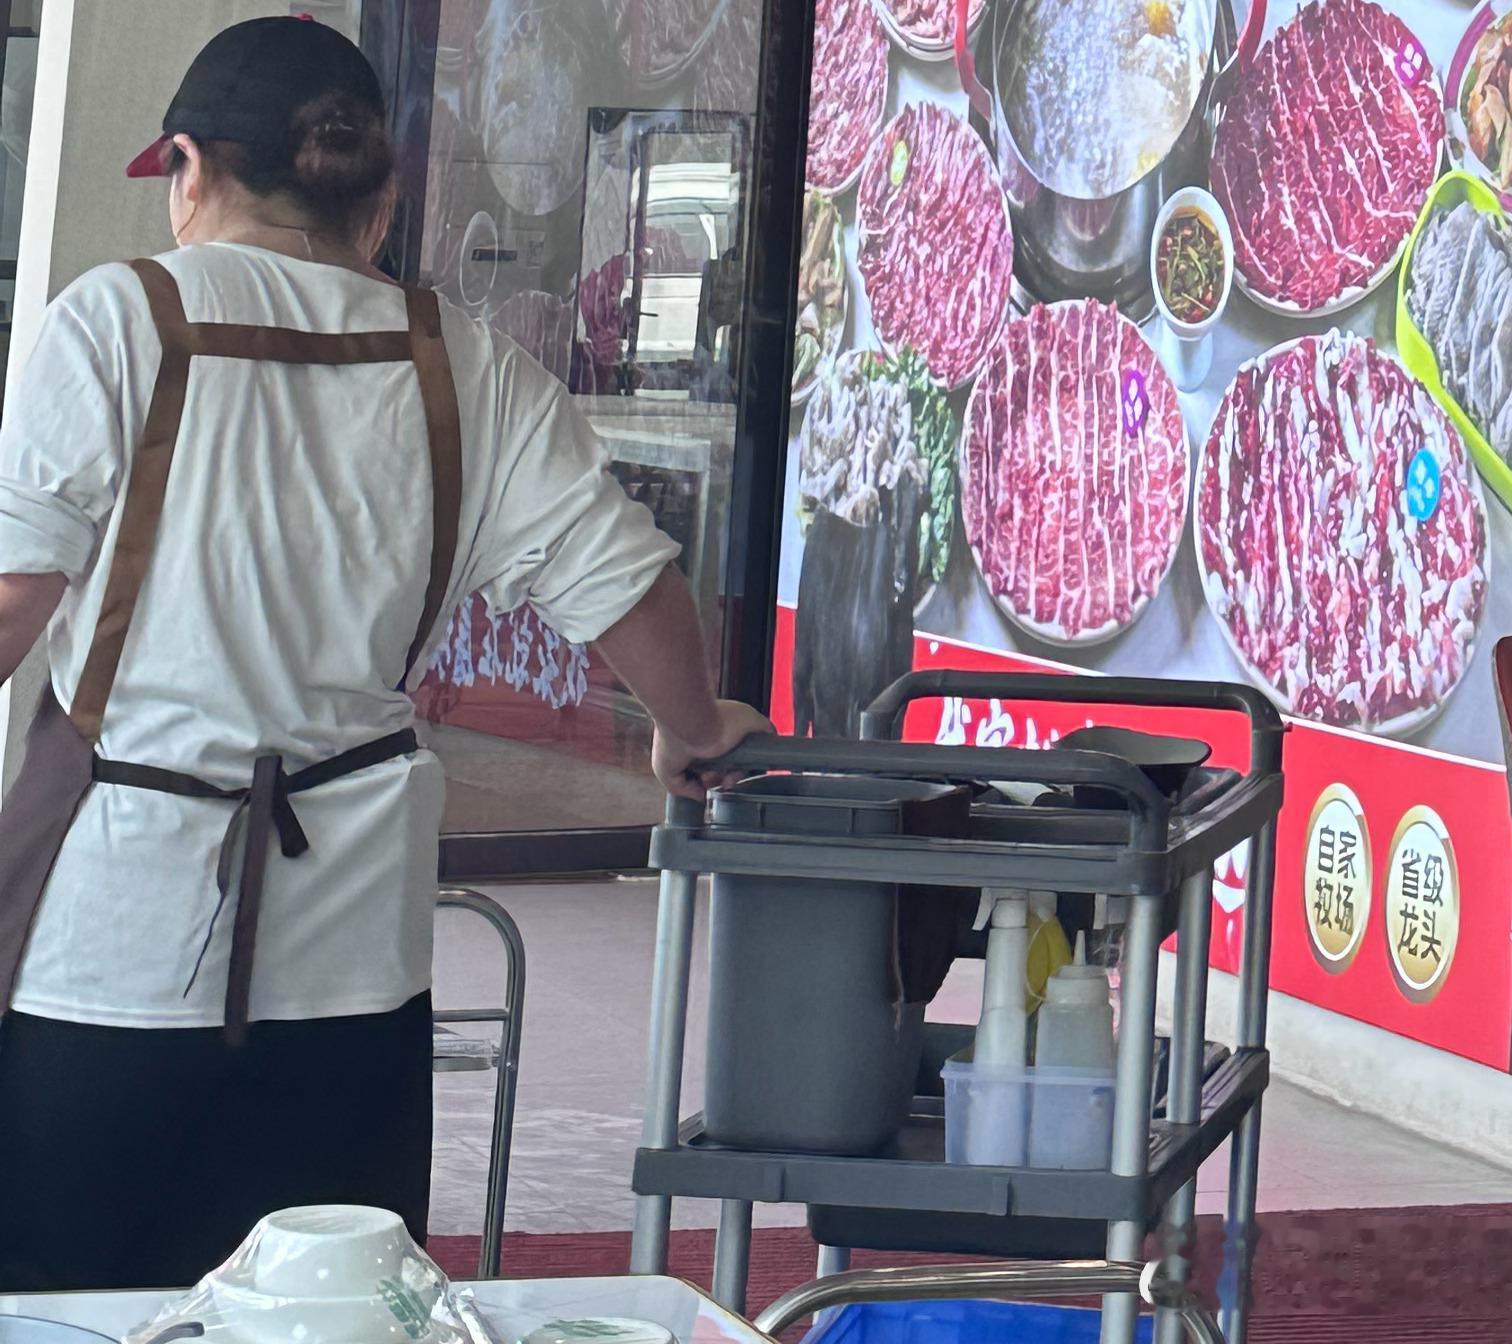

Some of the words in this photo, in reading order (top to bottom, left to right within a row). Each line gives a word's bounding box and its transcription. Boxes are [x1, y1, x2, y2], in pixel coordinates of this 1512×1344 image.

[1317, 824, 1357, 879] 自家
[1402, 848, 1444, 907] 省级
[1398, 903, 1442, 962] 龙头
